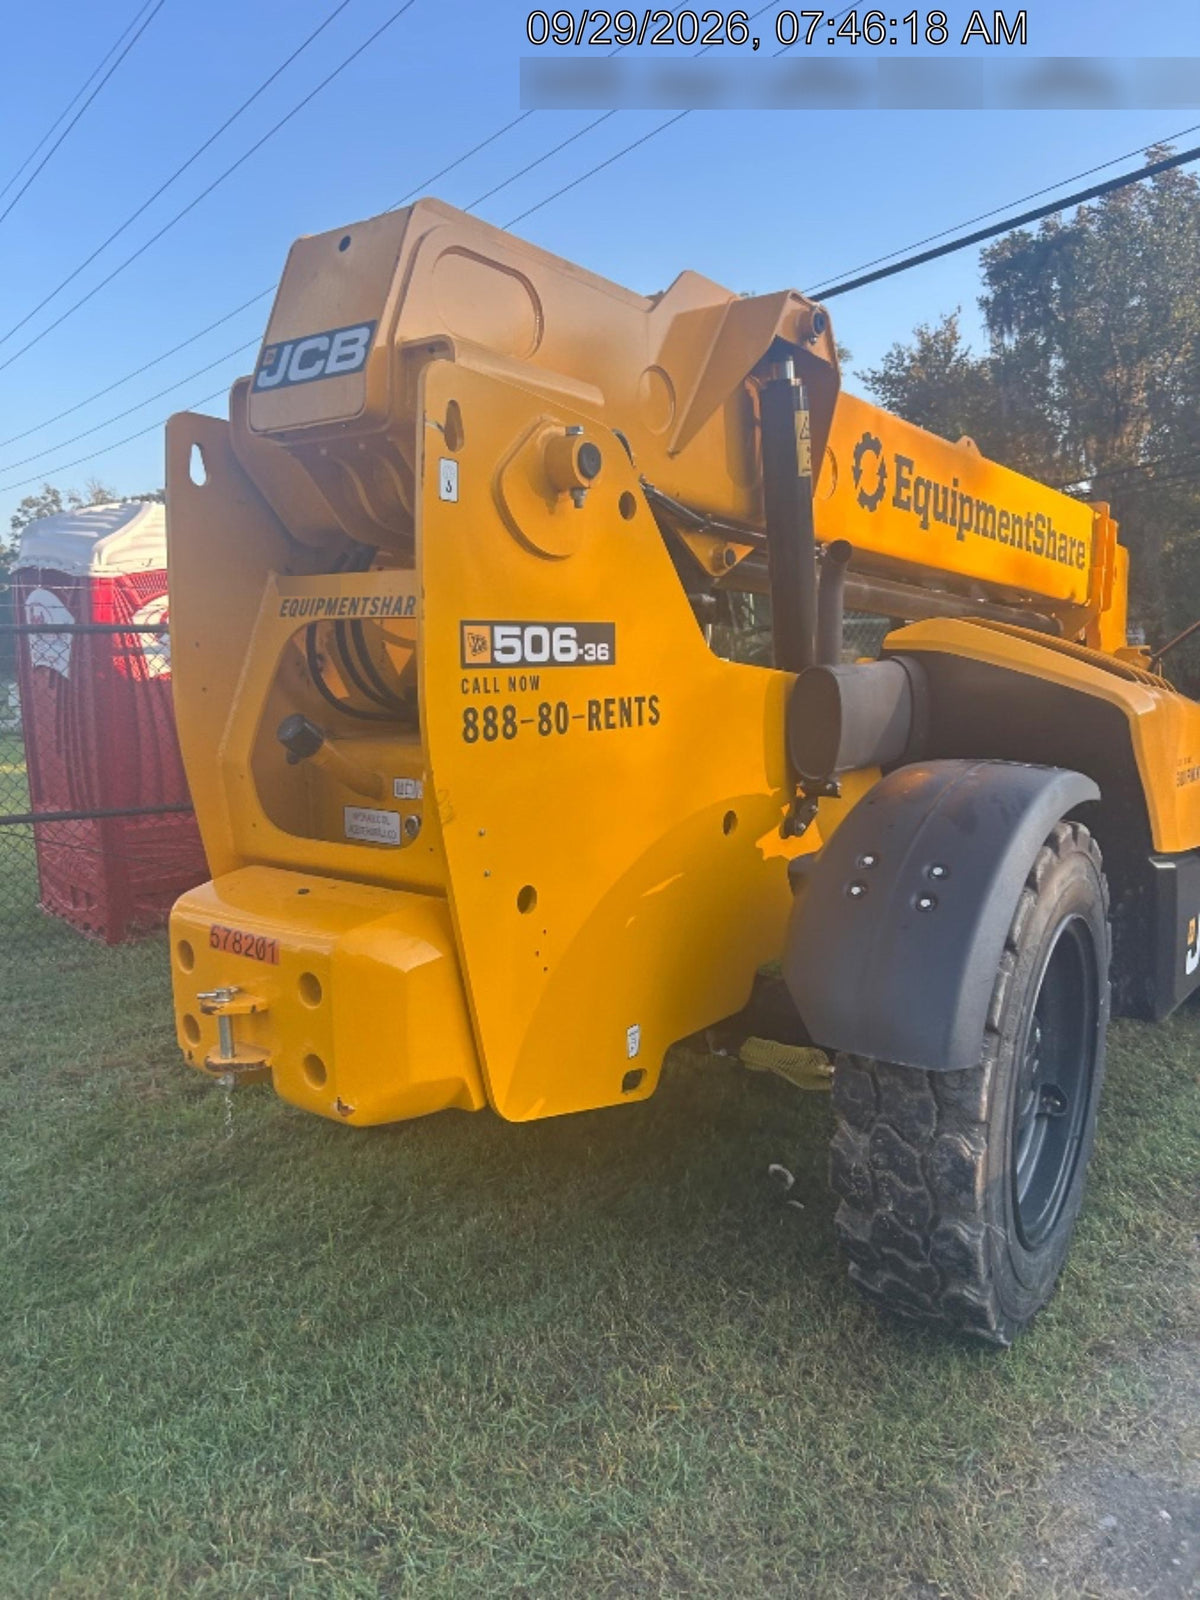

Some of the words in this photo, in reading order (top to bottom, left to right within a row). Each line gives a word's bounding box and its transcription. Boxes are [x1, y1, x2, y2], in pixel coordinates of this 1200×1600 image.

[257, 326, 371, 388] JCB
[892, 453, 1086, 571] EquipmentShare
[280, 596, 416, 617] EQUIPMENTSHAR
[461, 677, 499, 694] CALL
[508, 675, 540, 692] NOW
[462, 695, 660, 743] 888-80-RENTS
[210, 925, 277, 964] 578201
